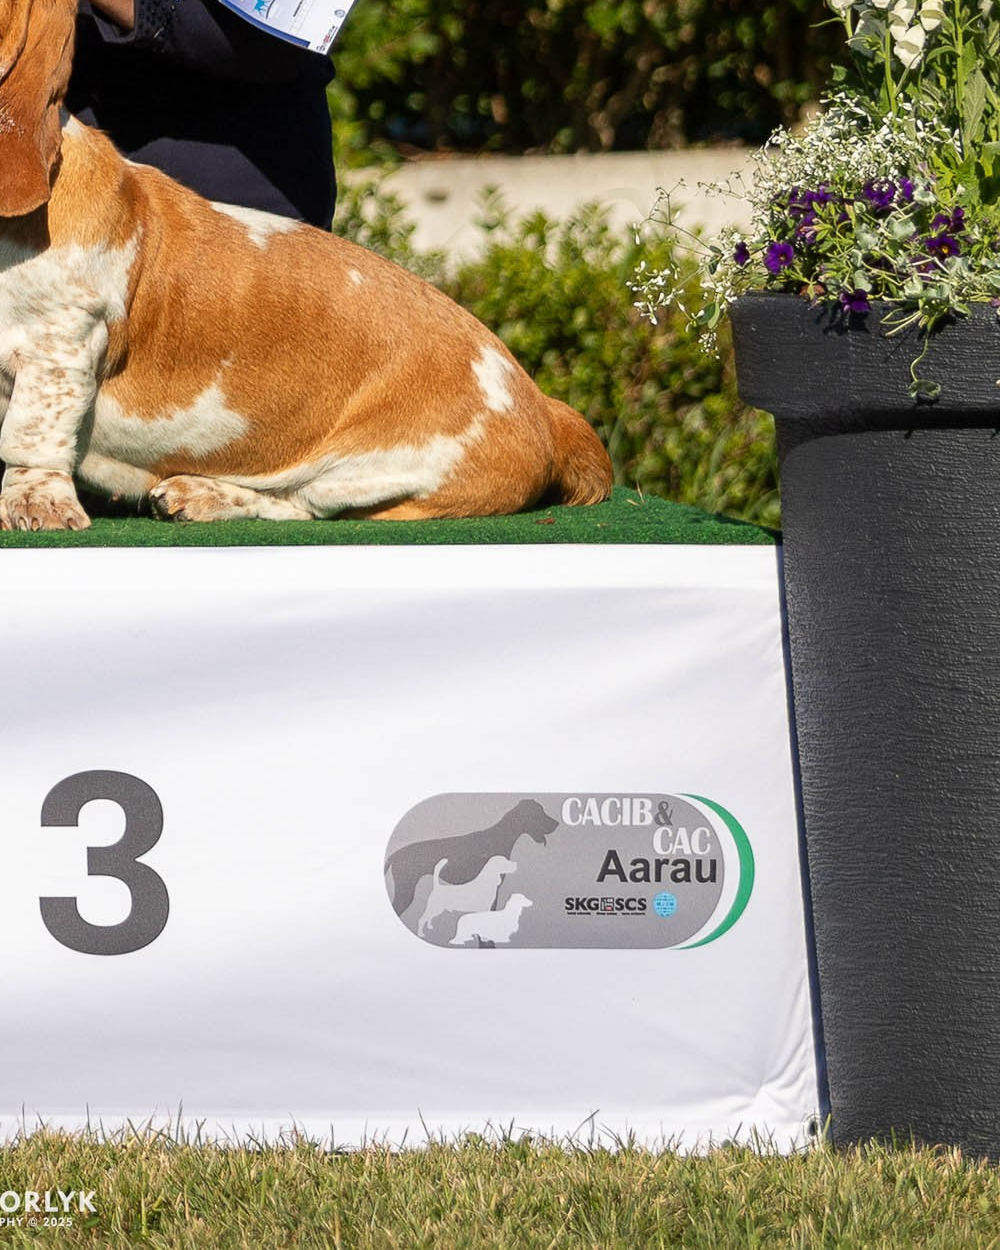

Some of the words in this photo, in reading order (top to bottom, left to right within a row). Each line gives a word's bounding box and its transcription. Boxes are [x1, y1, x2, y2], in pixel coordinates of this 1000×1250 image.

[653, 826, 711, 856] CAC
[39, 770, 169, 956] 3
[597, 850, 717, 884] Aarau
[564, 897, 600, 912] SKG
[614, 897, 648, 912] SCS
